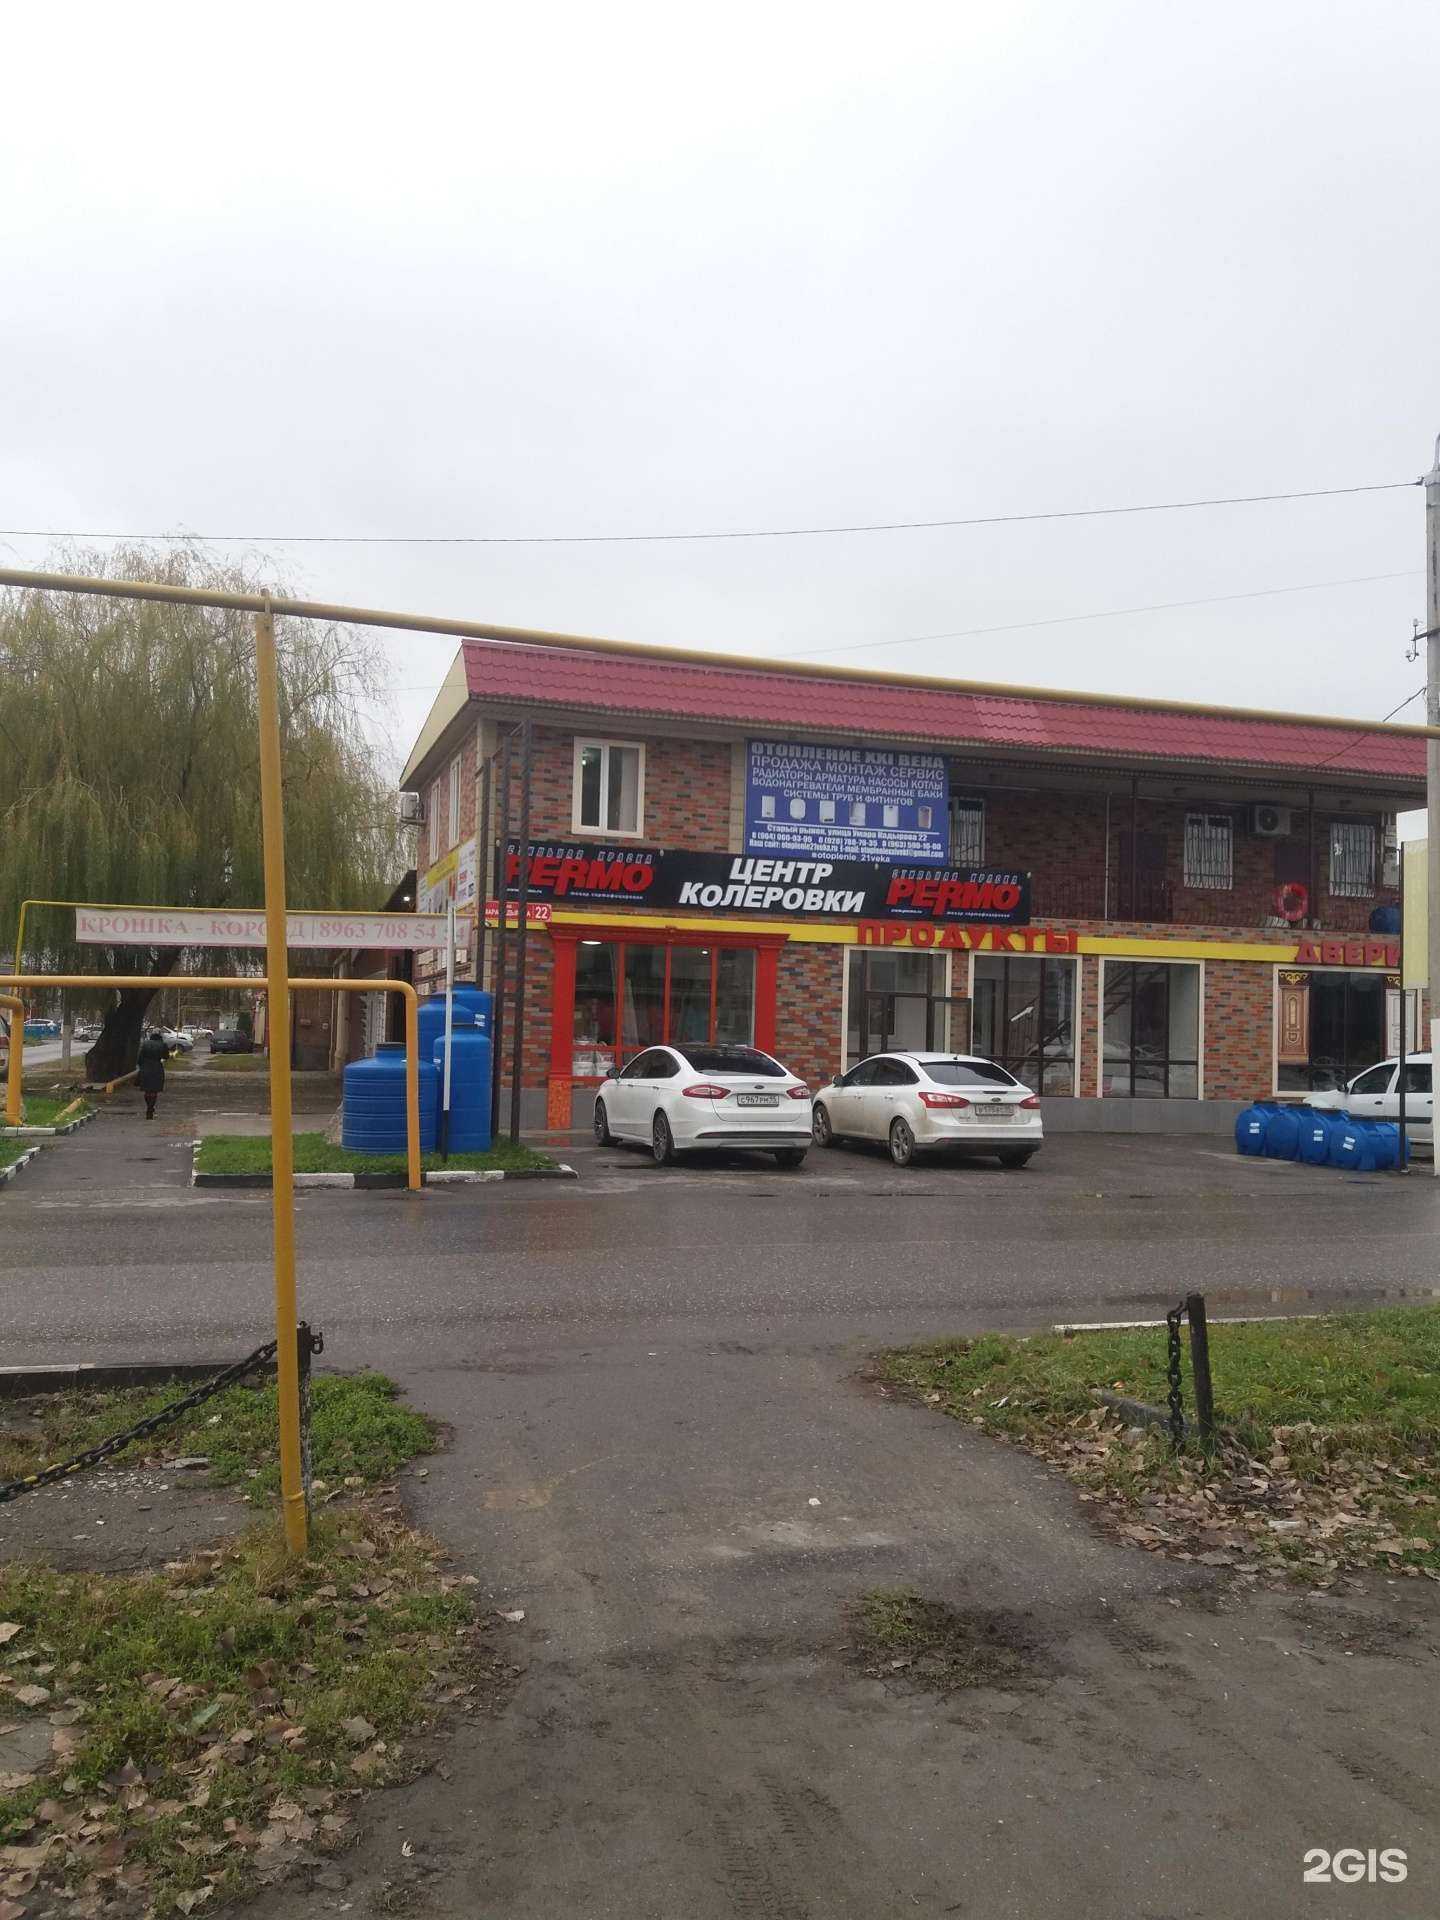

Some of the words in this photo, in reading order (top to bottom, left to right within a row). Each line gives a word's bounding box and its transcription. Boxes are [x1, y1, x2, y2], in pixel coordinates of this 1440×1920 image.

[751, 742, 861, 762] ОТОПЛЕНИЕ
[751, 755, 822, 771] ПРОДАЖА
[826, 762, 887, 777] МОНТАЖ
[890, 766, 944, 780] СЕРВИС
[752, 767, 813, 780] РАДИАТОРЫ
[815, 772, 866, 785] АРМАТУРА
[868, 776, 909, 788] НАСОСЫ
[911, 780, 943, 790] КОТЛЫ
[752, 777, 845, 792] ВОДОНАГРЕВАТЕЛИ
[847, 784, 915, 798] МЕМБРАННЫЕ
[917, 790, 943, 799] БАКИ
[783, 789, 829, 800] СИСТЕМЫ
[831, 792, 854, 802] ТРУБ
[856, 794, 863, 802] И
[865, 795, 913, 806] ФИТИНГОВ
[767, 824, 798, 833] Старый
[918, 833, 928, 841] 22
[505, 854, 656, 896] PERMO
[729, 858, 833, 885] ЦЕНТР
[679, 881, 866, 912] КОЛЕРОВКИ
[886, 877, 1021, 915] PERMO
[535, 906, 548, 919] 22
[80, 915, 190, 934] КРОШКА
[208, 919, 305, 938] КОРОД
[319, 921, 366, 939] 8963
[374, 922, 408, 939] 708
[413, 923, 437, 940] 54
[857, 920, 1080, 953] ПРОДУКТЫ
